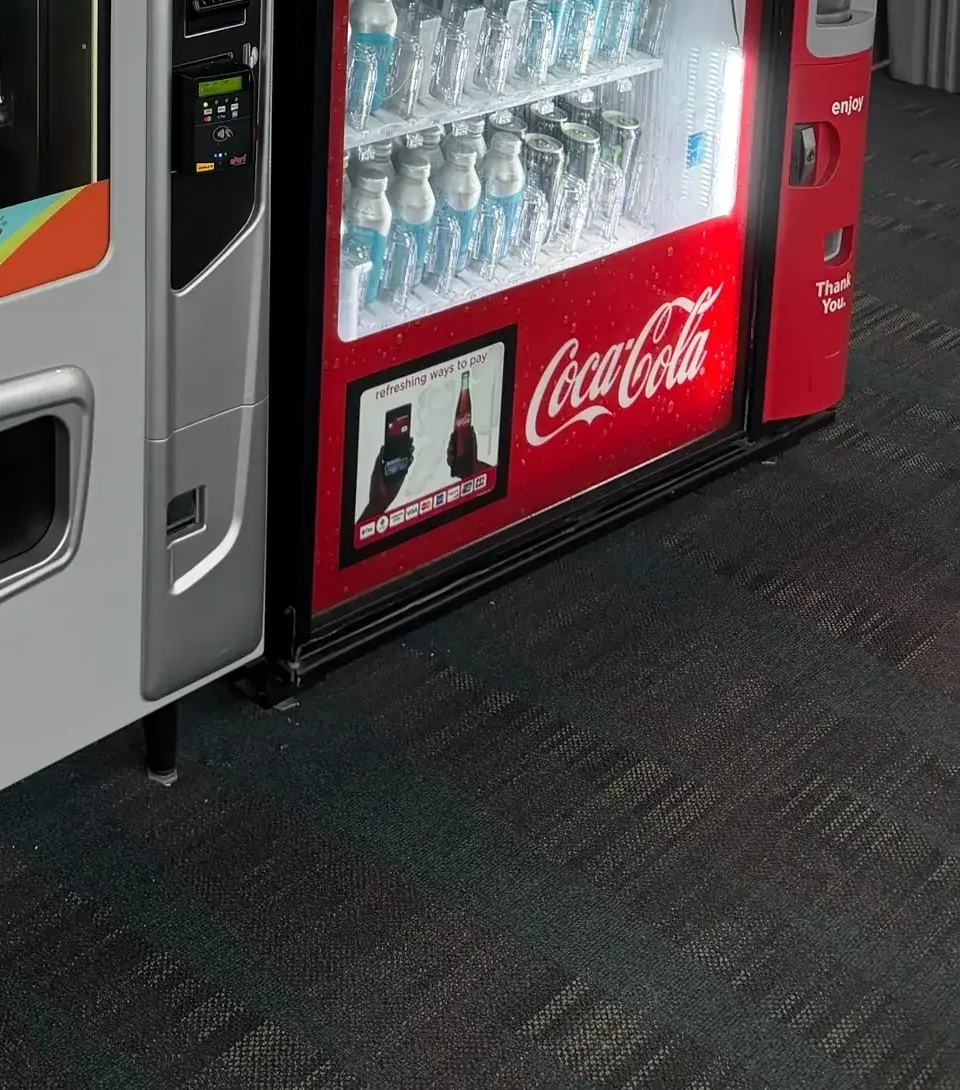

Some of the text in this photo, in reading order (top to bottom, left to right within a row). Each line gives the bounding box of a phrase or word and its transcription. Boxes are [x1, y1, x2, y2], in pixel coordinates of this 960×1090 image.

[831, 94, 865, 116] enjoy
[815, 271, 852, 298] Thank
[821, 294, 846, 314] You.
[375, 350, 489, 401] refreshing ways to pay
[524, 282, 725, 447] Coca-Cola
